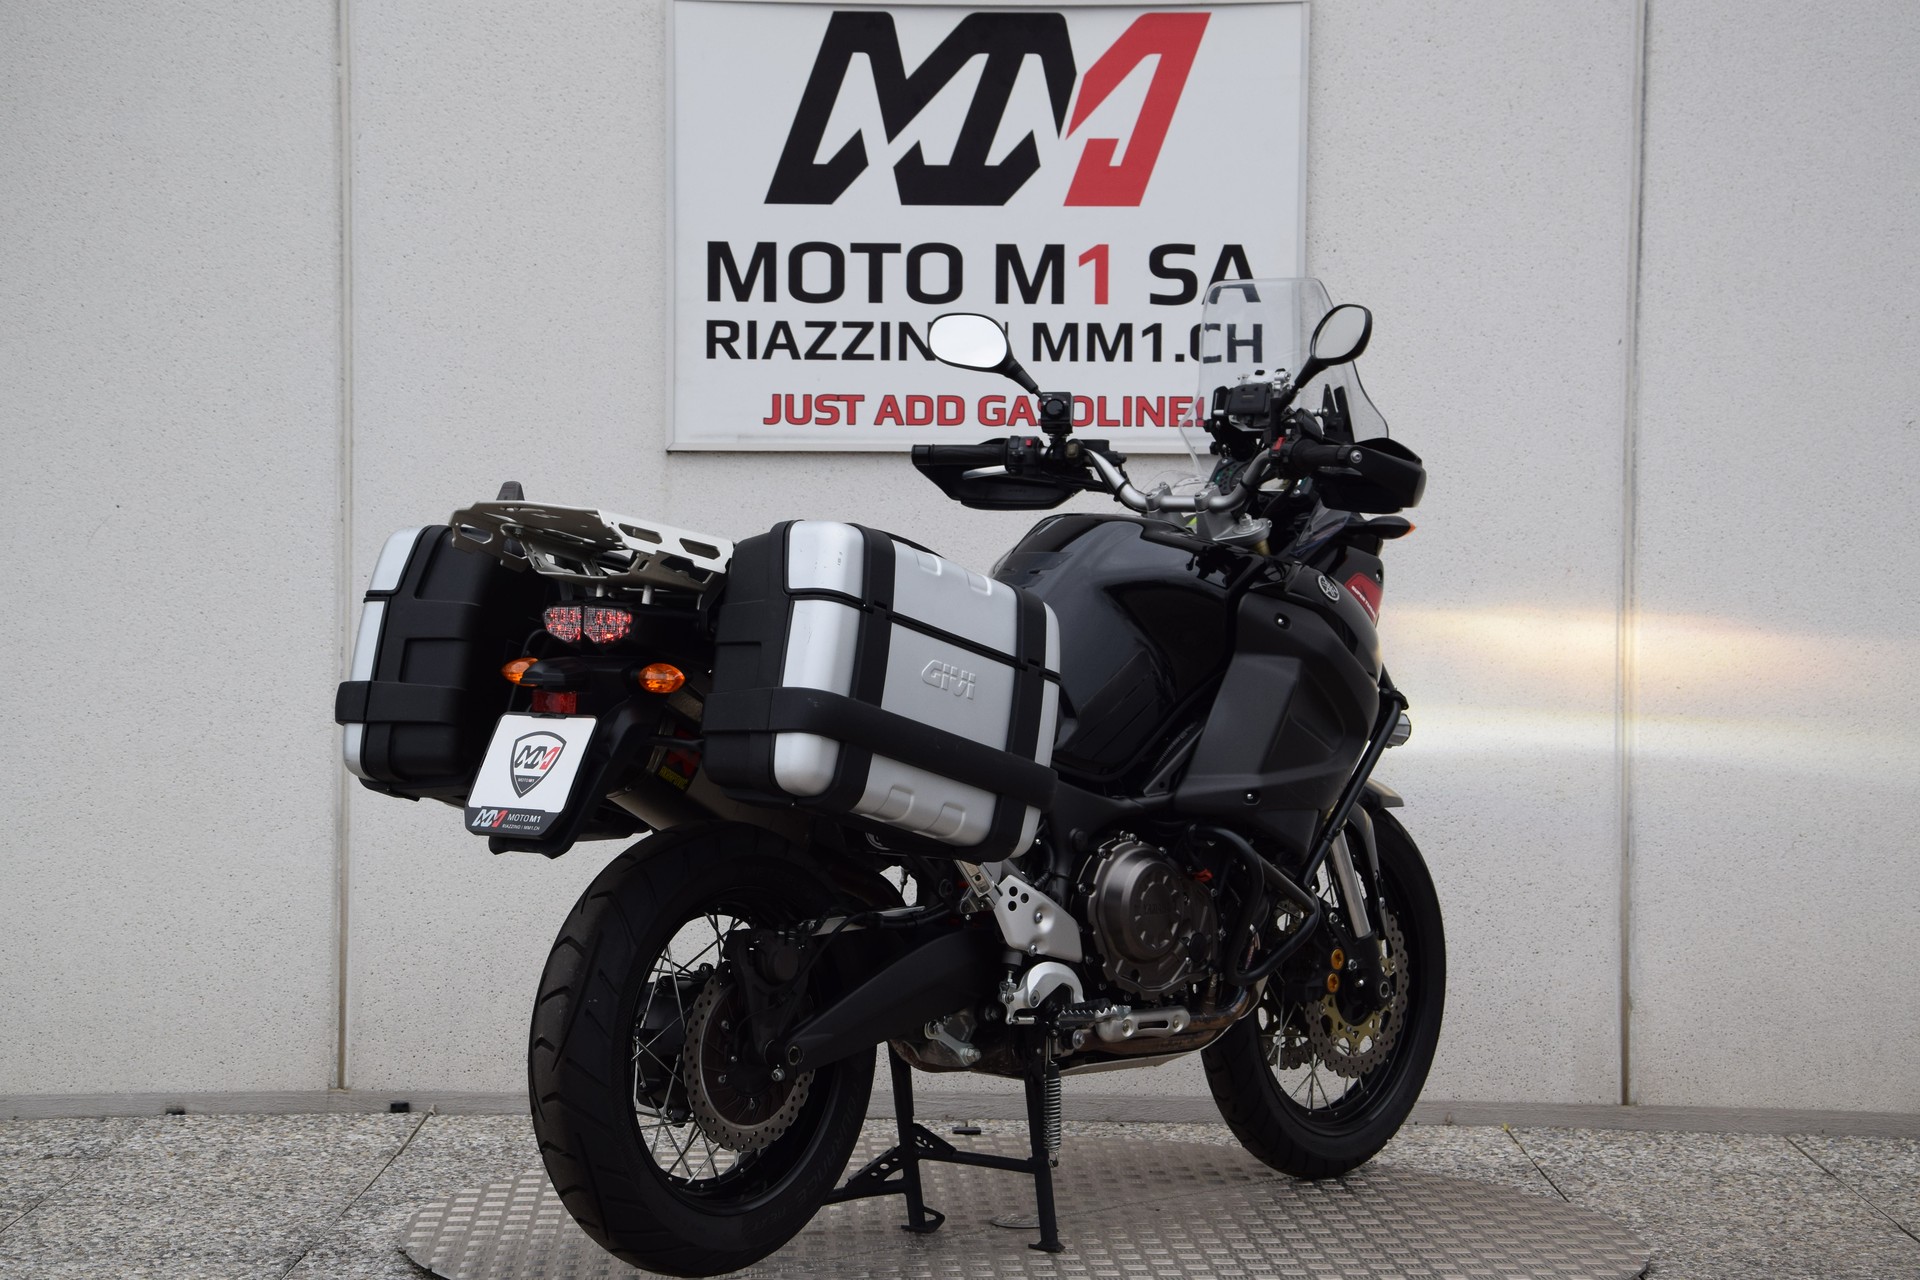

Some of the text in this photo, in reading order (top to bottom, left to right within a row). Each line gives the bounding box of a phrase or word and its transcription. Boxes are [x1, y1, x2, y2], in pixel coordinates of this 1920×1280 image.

[707, 241, 1262, 306] MOTO M1 SA
[706, 320, 1263, 364] RIAZZIN MM1.CH
[763, 394, 1205, 428] JUST ADD GAOLINE!
